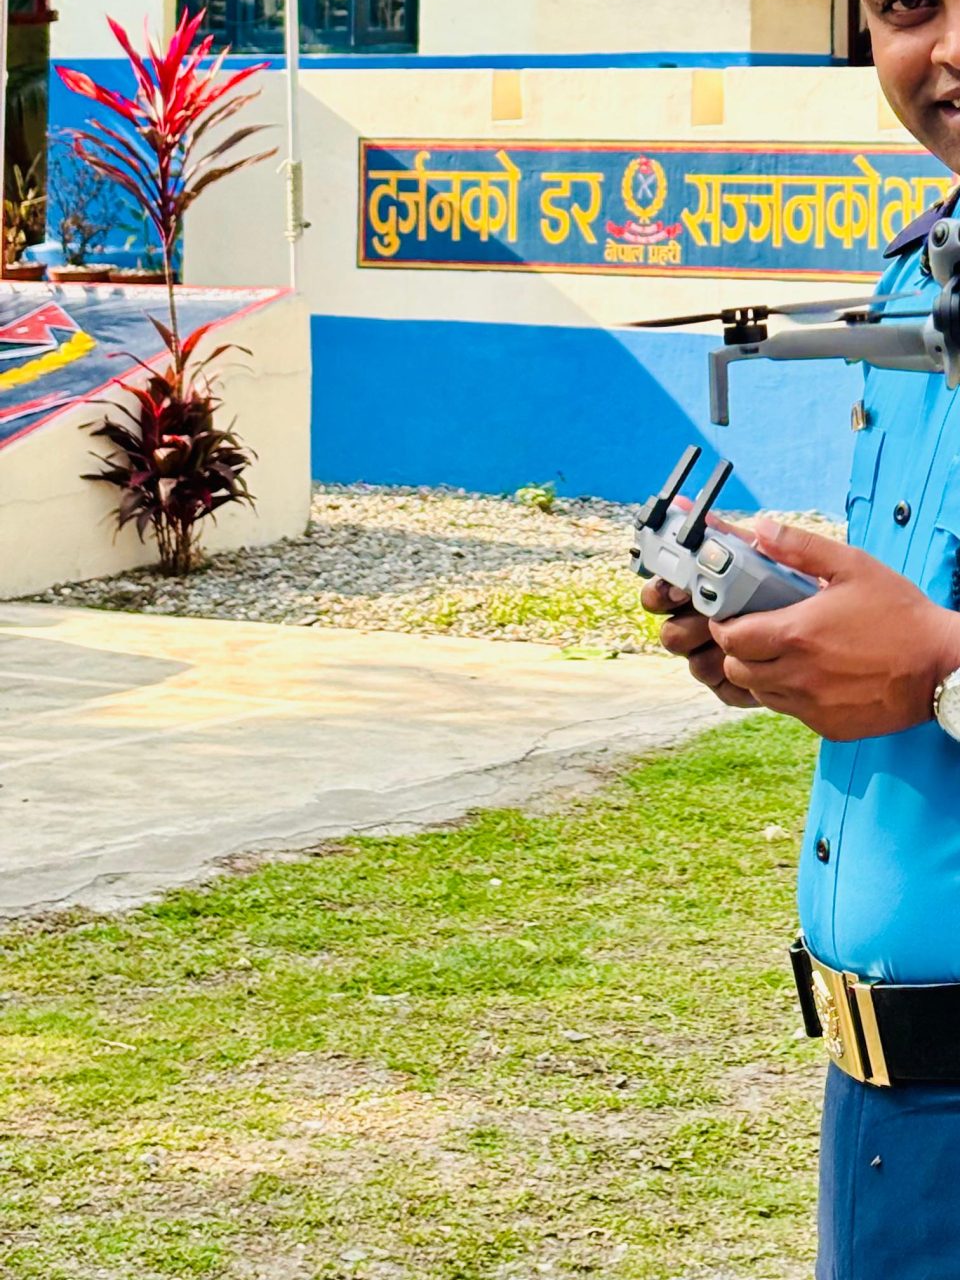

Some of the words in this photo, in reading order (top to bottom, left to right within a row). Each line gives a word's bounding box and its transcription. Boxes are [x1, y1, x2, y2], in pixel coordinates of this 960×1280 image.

[369, 150, 521, 256] दुर्जनको
[540, 171, 603, 245] डर
[680, 153, 881, 251] सज्जनको
